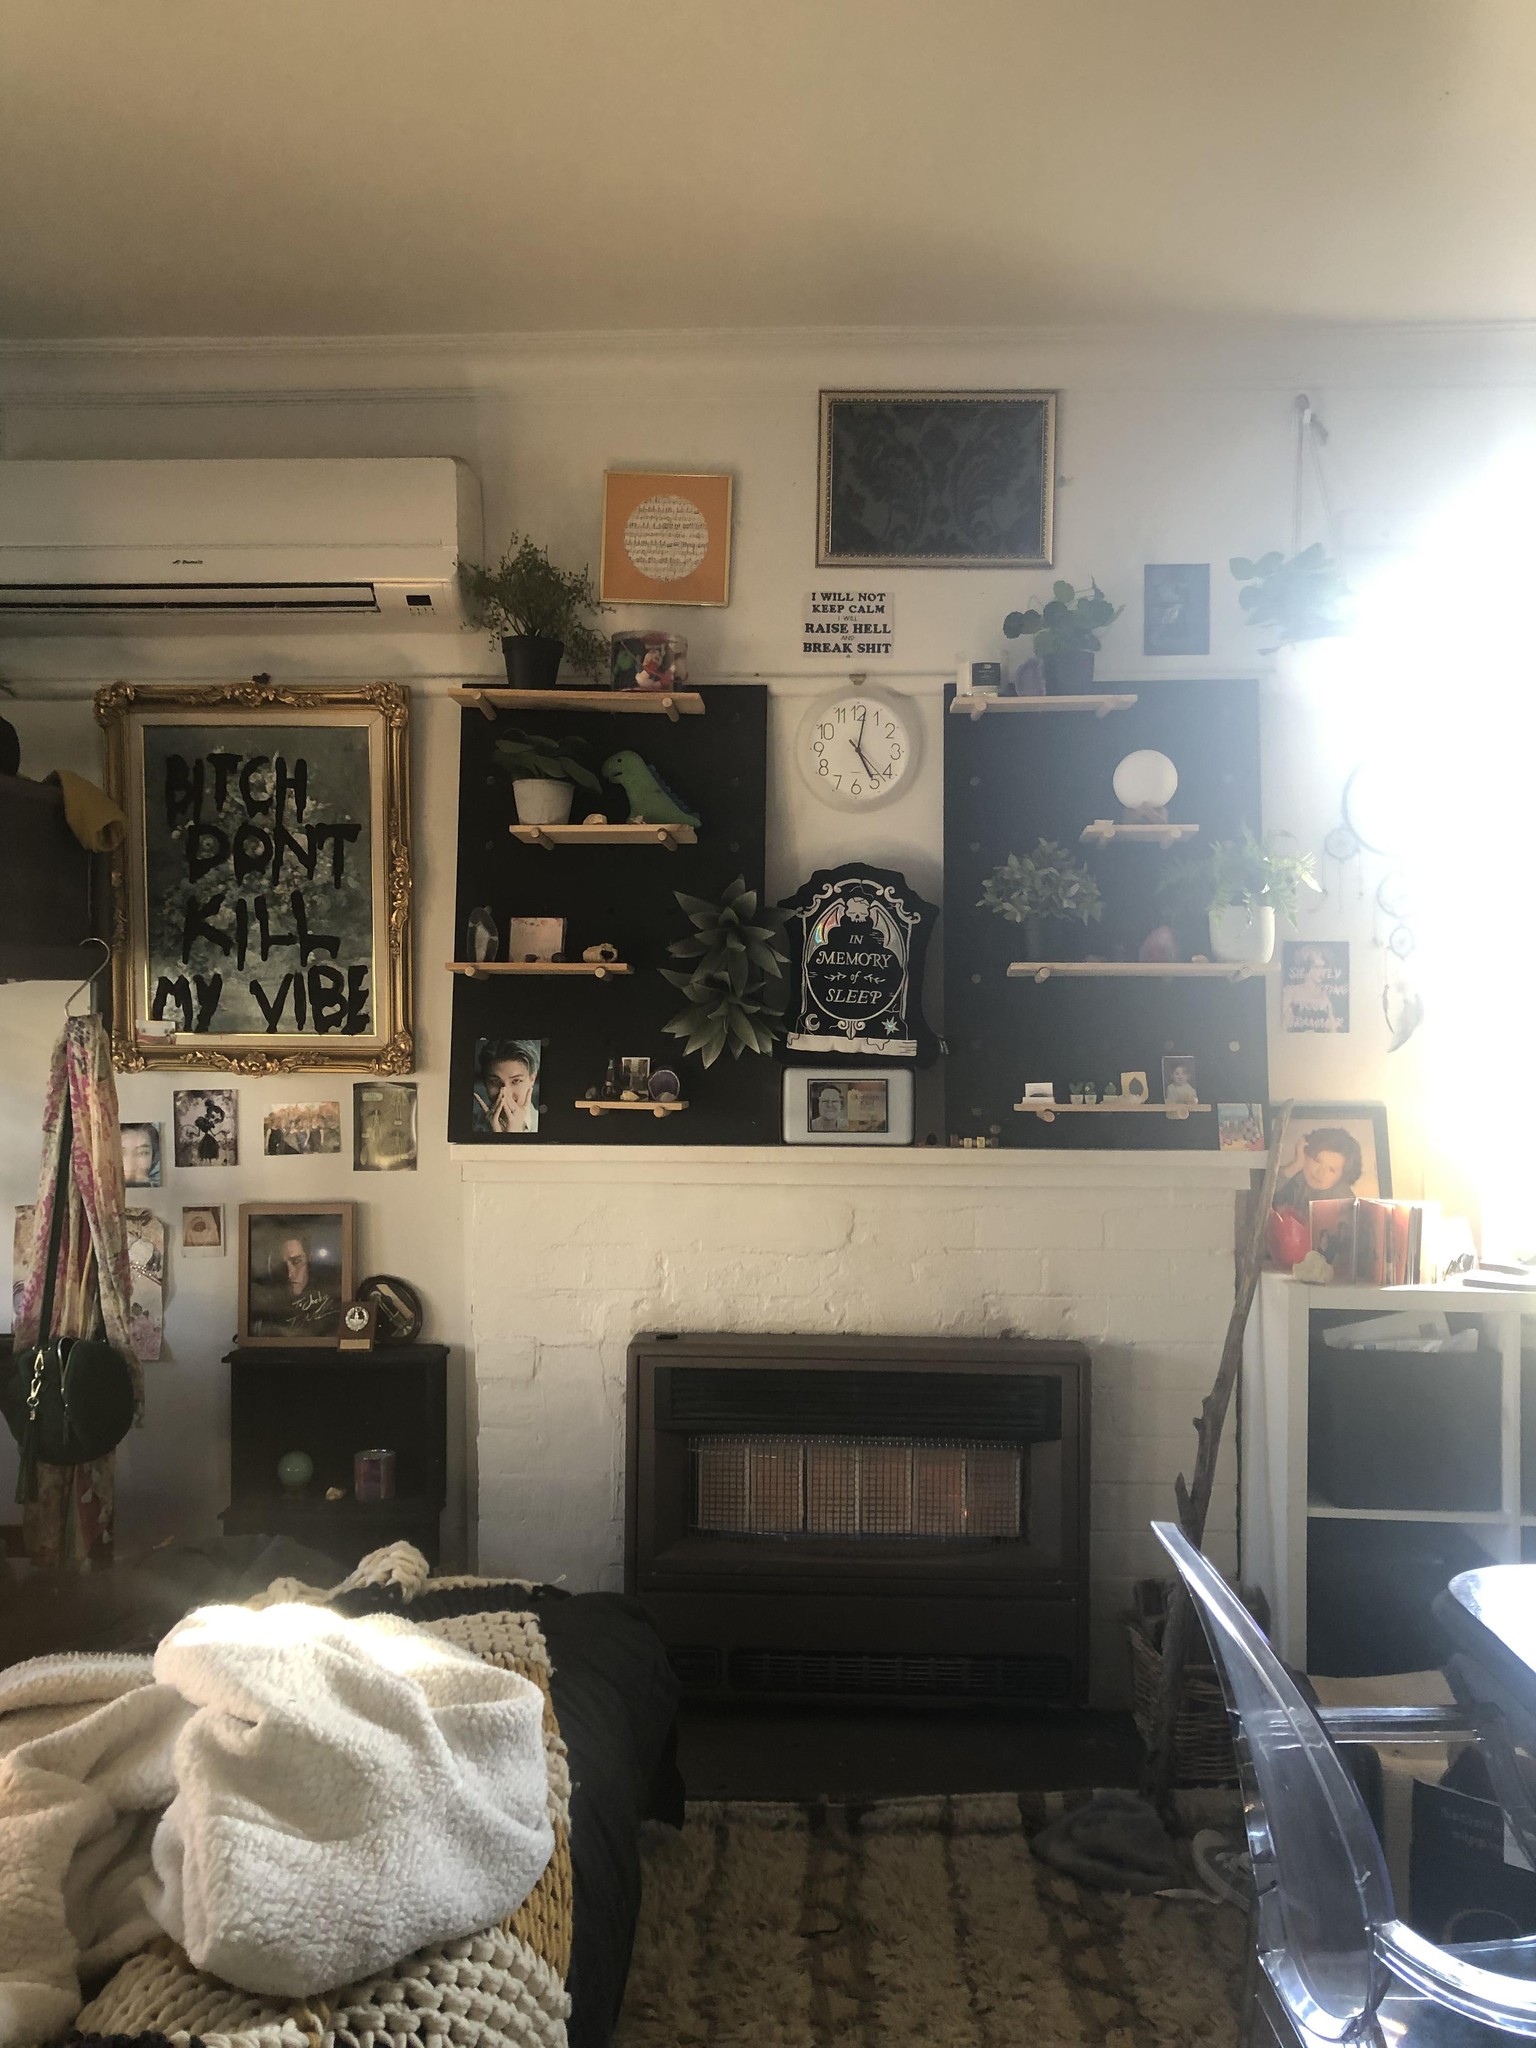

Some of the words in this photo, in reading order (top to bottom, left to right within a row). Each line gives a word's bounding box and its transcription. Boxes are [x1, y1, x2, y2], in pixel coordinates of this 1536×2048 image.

[811, 592, 816, 601] I
[820, 592, 854, 601] WILL
[858, 592, 886, 601] NOT
[812, 604, 845, 613] KEEP
[848, 604, 885, 614] CALM
[804, 622, 849, 634] RAISE
[852, 623, 892, 634] HELL
[803, 642, 853, 653] BREAK
[856, 643, 892, 653] SHIT
[834, 708, 846, 723] 11
[850, 705, 867, 722] 12
[873, 711, 879, 726] 1
[817, 722, 835, 740] 10
[884, 722, 896, 739] 2
[813, 741, 825, 757] 9
[890, 743, 901, 760] 3
[818, 758, 829, 776] 8
[882, 763, 893, 779] 4
[165, 752, 307, 828] BITCH
[833, 774, 842, 790] 7
[850, 778, 862, 795] 6
[869, 773, 881, 790] 5
[182, 890, 341, 971] KILL
[848, 934, 864, 945] IN
[815, 950, 893, 970] MEMORY
[850, 971, 861, 985] of
[152, 972, 223, 1033] MY
[250, 965, 371, 1036] VIBE
[825, 988, 883, 1005] SLEEP
